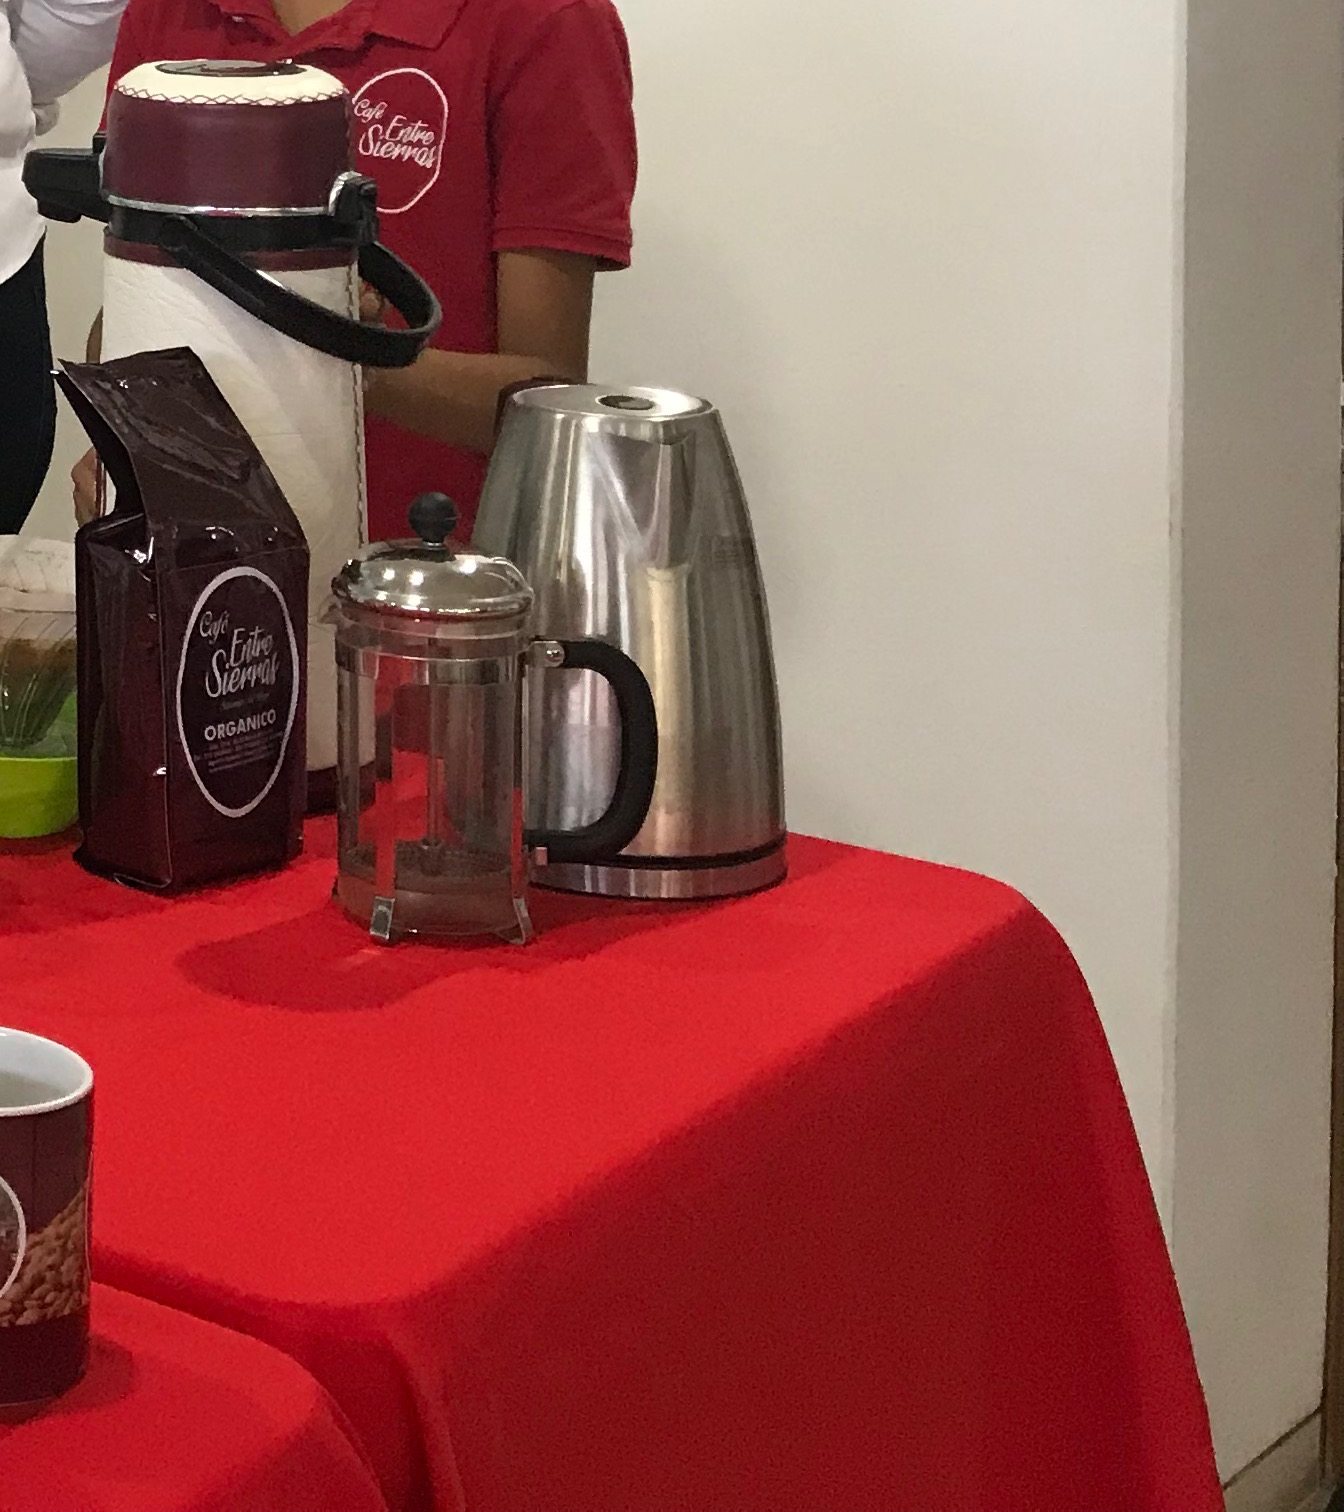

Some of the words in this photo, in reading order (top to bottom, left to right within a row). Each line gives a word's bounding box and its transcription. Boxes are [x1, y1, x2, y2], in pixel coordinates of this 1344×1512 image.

[359, 123, 436, 168] Sierras
[386, 114, 435, 145] Entre
[229, 625, 273, 667] Entre
[205, 648, 280, 697] Sierras
[204, 708, 276, 741] ORGANICO
